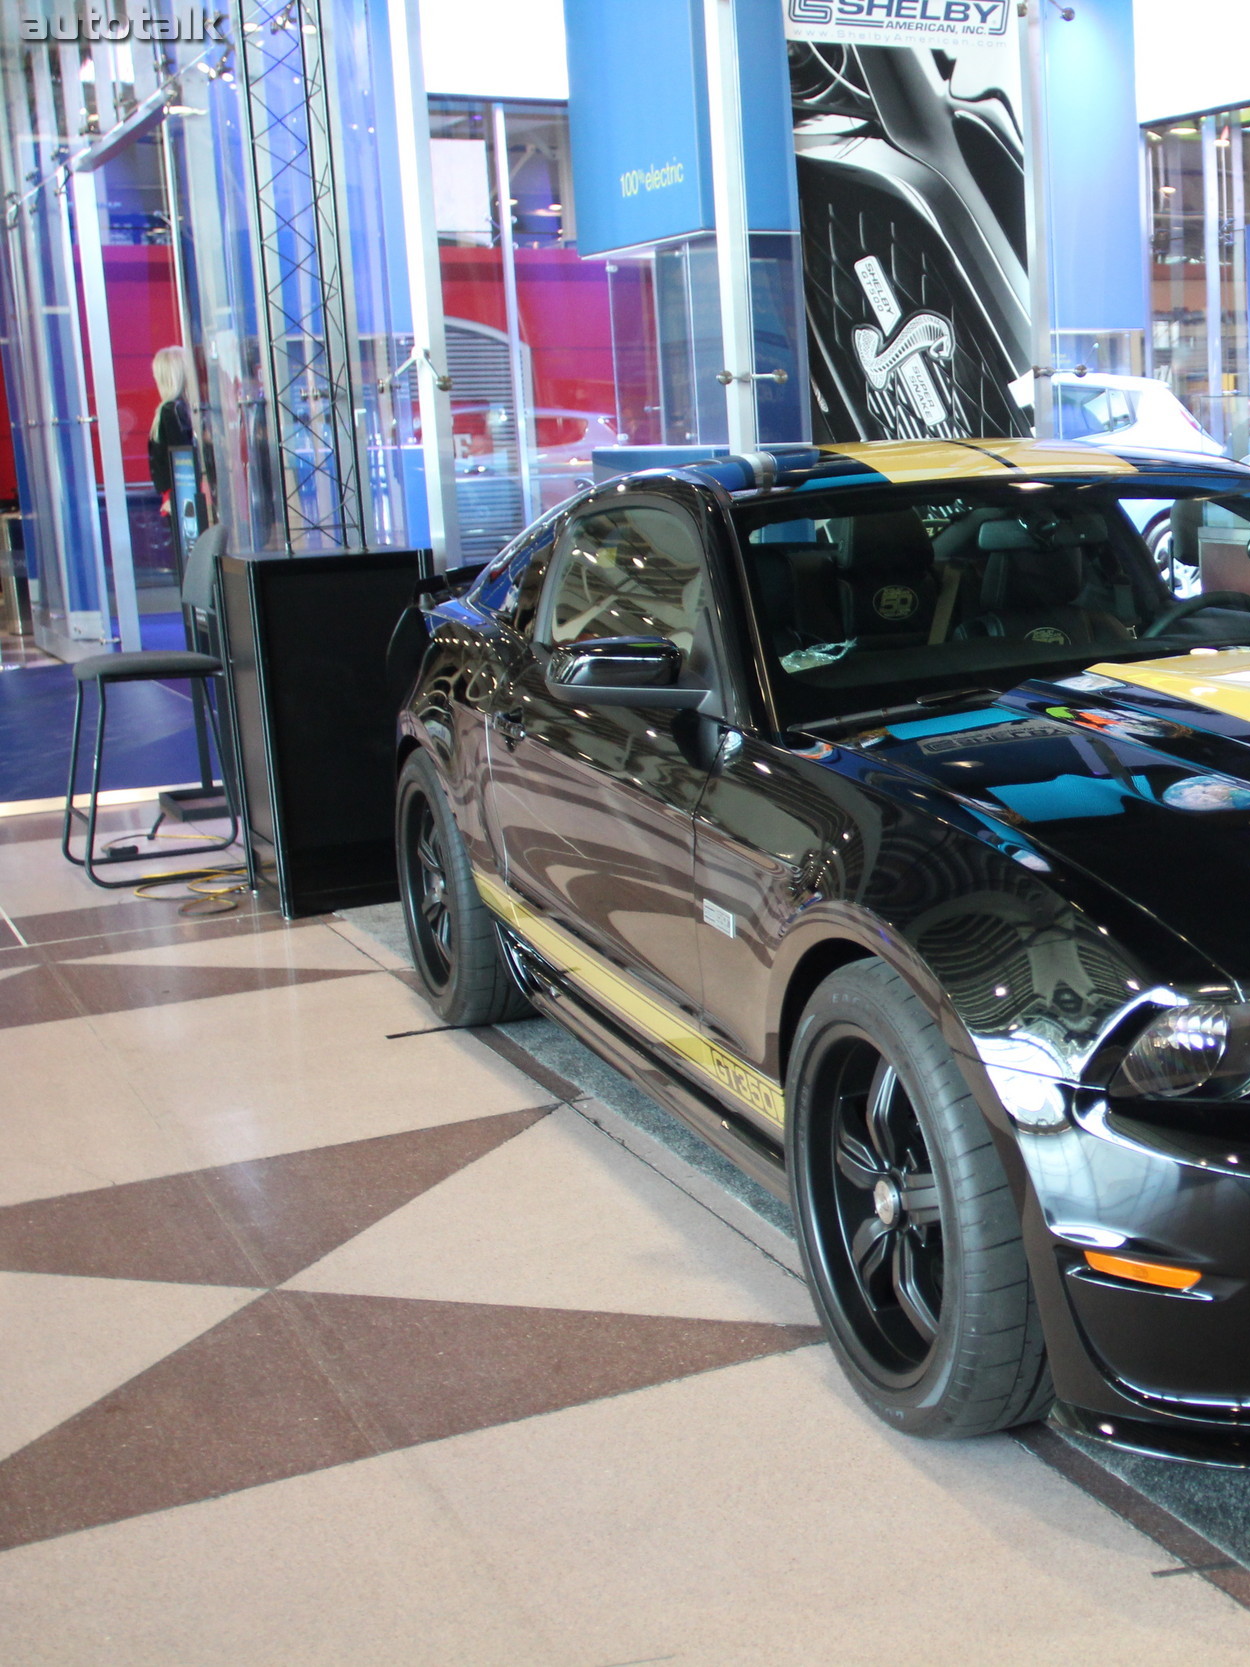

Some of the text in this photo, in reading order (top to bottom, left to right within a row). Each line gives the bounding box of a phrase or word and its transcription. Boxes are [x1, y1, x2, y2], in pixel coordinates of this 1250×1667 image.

[837, 0, 1000, 24] SHELBY
[885, 20, 987, 35] AMERICAN, INC.
[861, 271, 884, 313] GT500
[864, 262, 894, 315] SHELBY
[908, 375, 933, 418] SNAKE
[912, 365, 935, 408] SUPER
[711, 1050, 776, 1116] GT350
